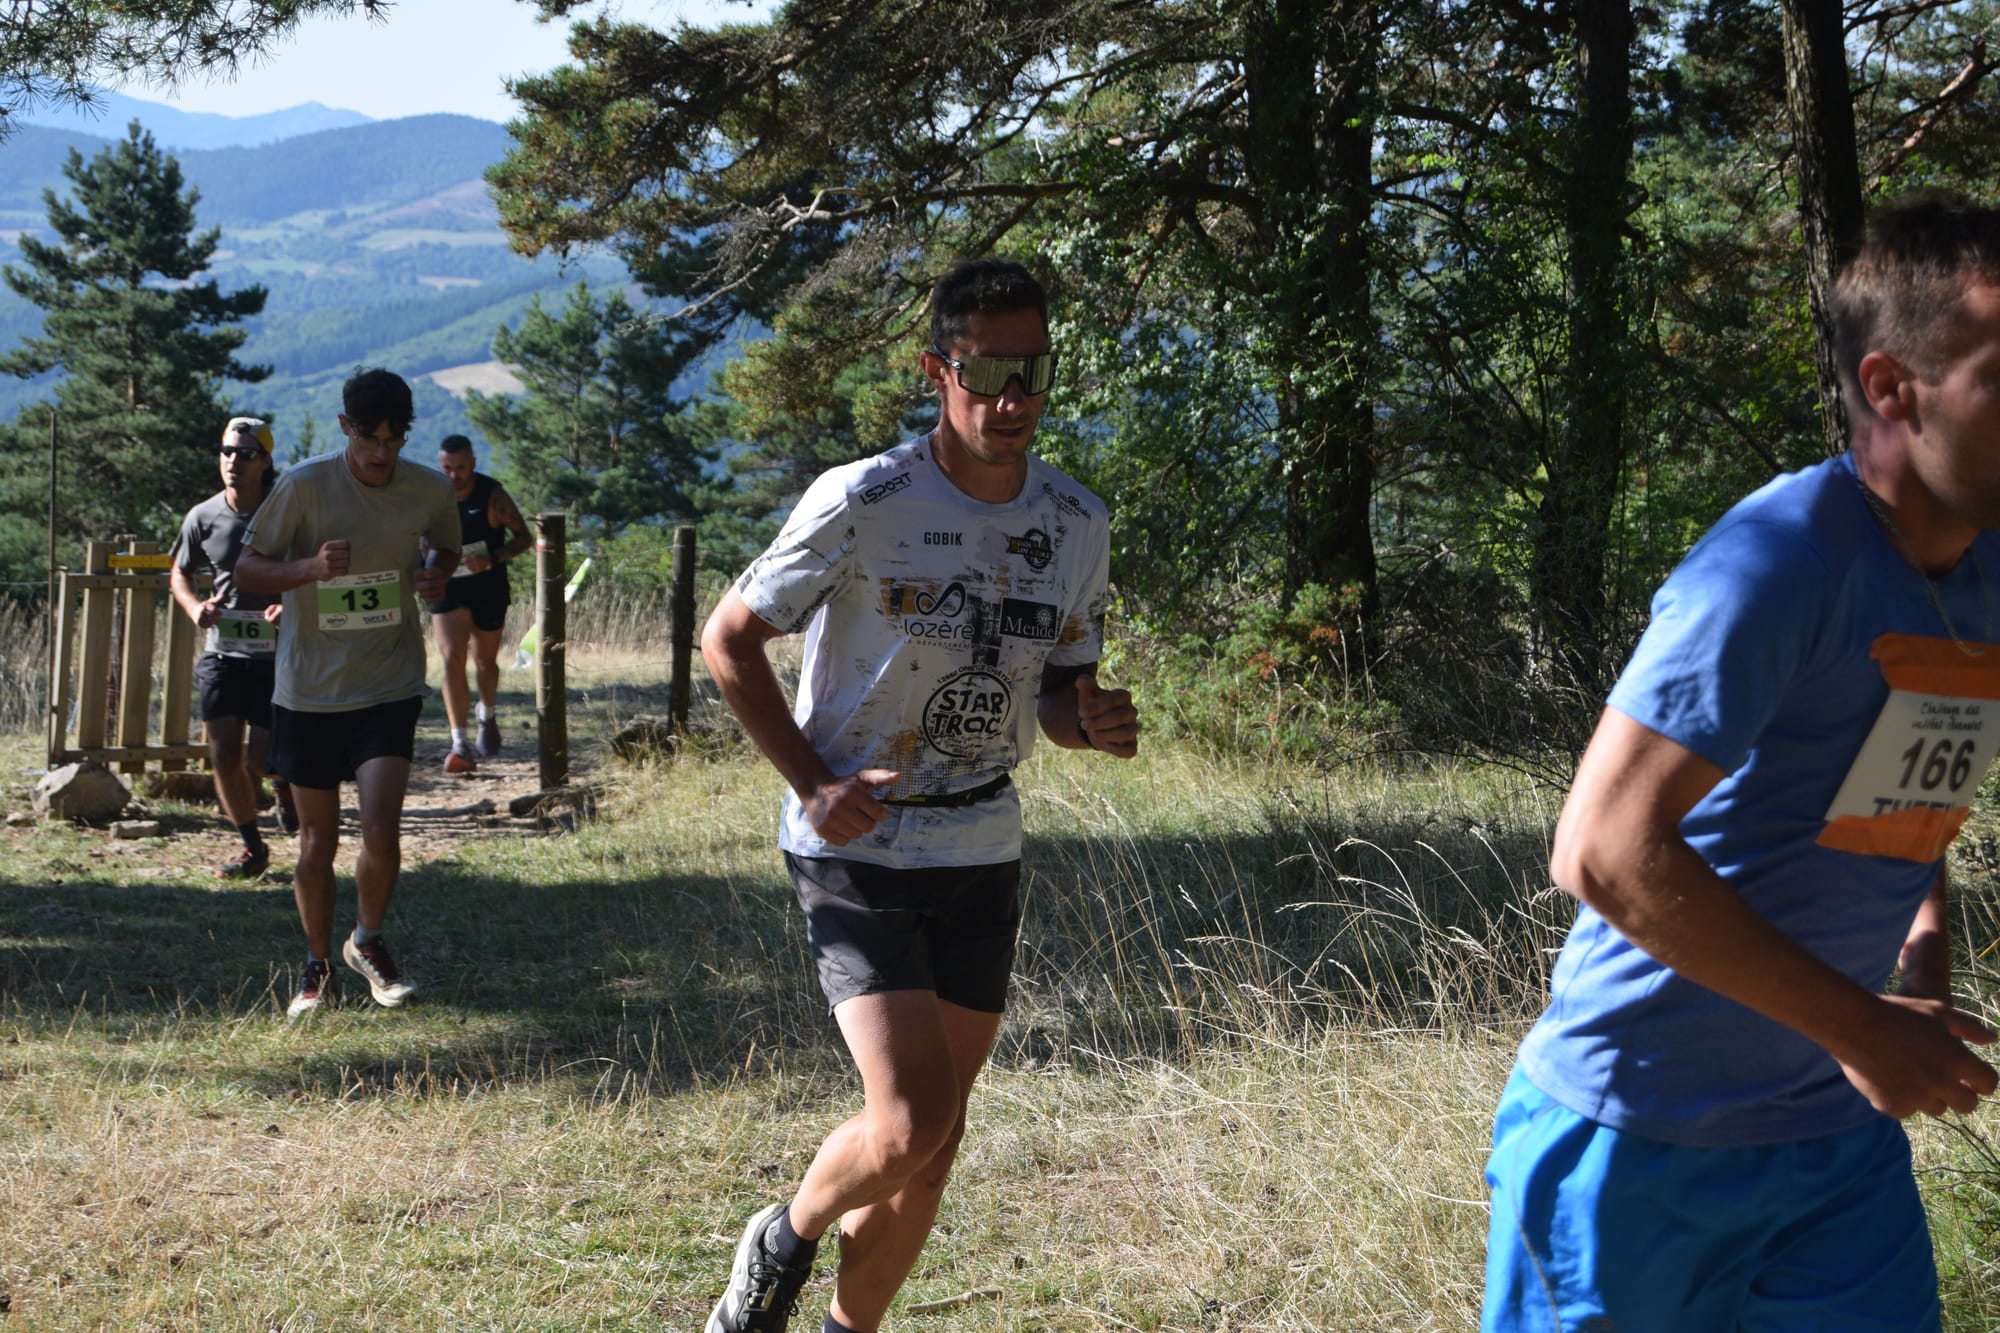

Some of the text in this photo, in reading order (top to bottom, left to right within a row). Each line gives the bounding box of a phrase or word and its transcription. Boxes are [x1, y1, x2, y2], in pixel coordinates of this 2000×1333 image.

[924, 531, 963, 546] GOBIK
[341, 588, 380, 612] 13
[232, 621, 260, 639] 16
[904, 618, 975, 640] lozère
[1004, 615, 1054, 639] Mende
[938, 689, 1004, 715] STAR
[932, 713, 1001, 736] TROC
[1898, 737, 1975, 793] 166
